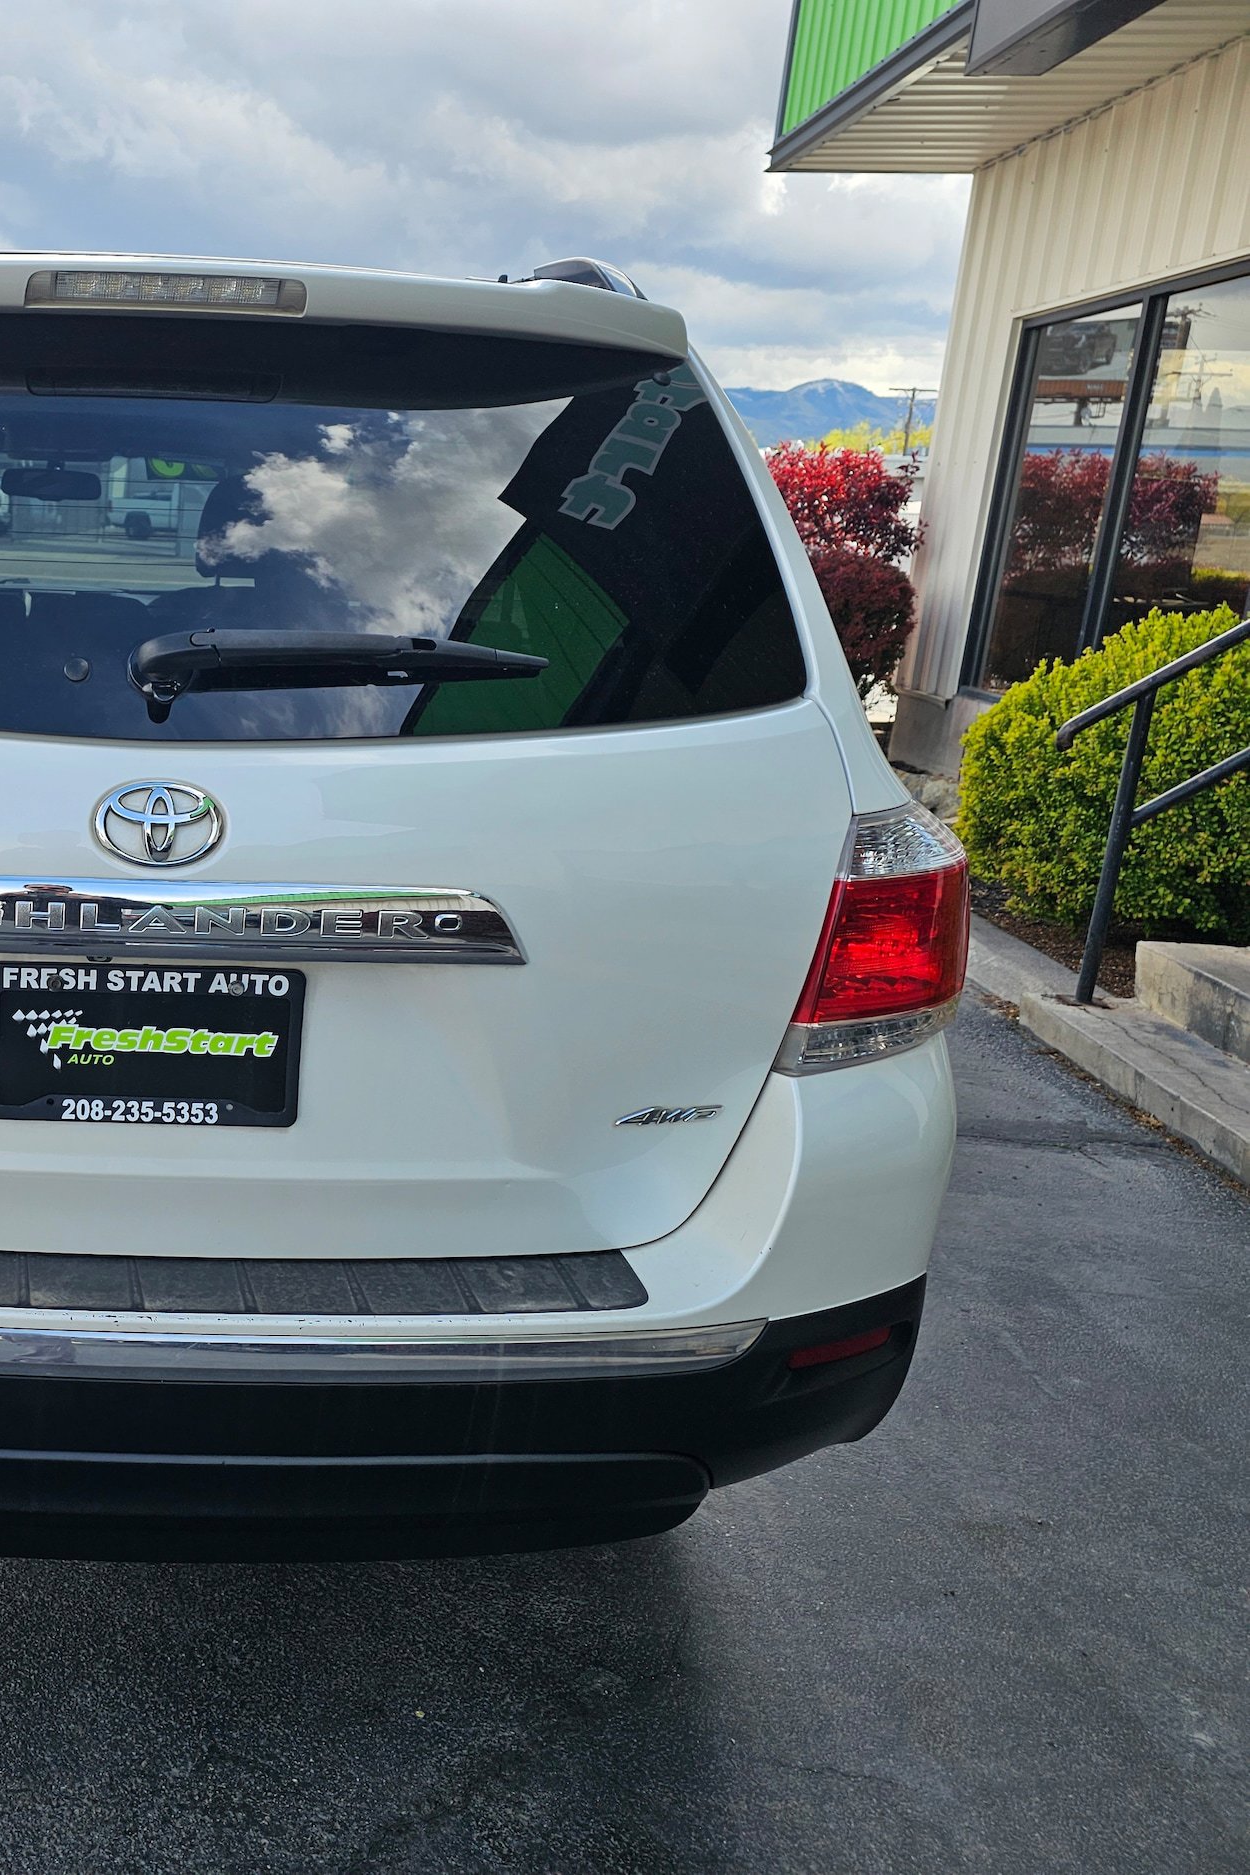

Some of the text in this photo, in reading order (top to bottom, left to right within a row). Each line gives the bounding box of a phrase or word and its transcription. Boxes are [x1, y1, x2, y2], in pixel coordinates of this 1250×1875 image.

[2, 967, 290, 997] FRESH START AUTO
[47, 1024, 279, 1058] FreshStart
[67, 1053, 115, 1066] AUTO
[61, 1098, 219, 1125] 208-235-5353
[614, 1104, 724, 1126] 4WD
